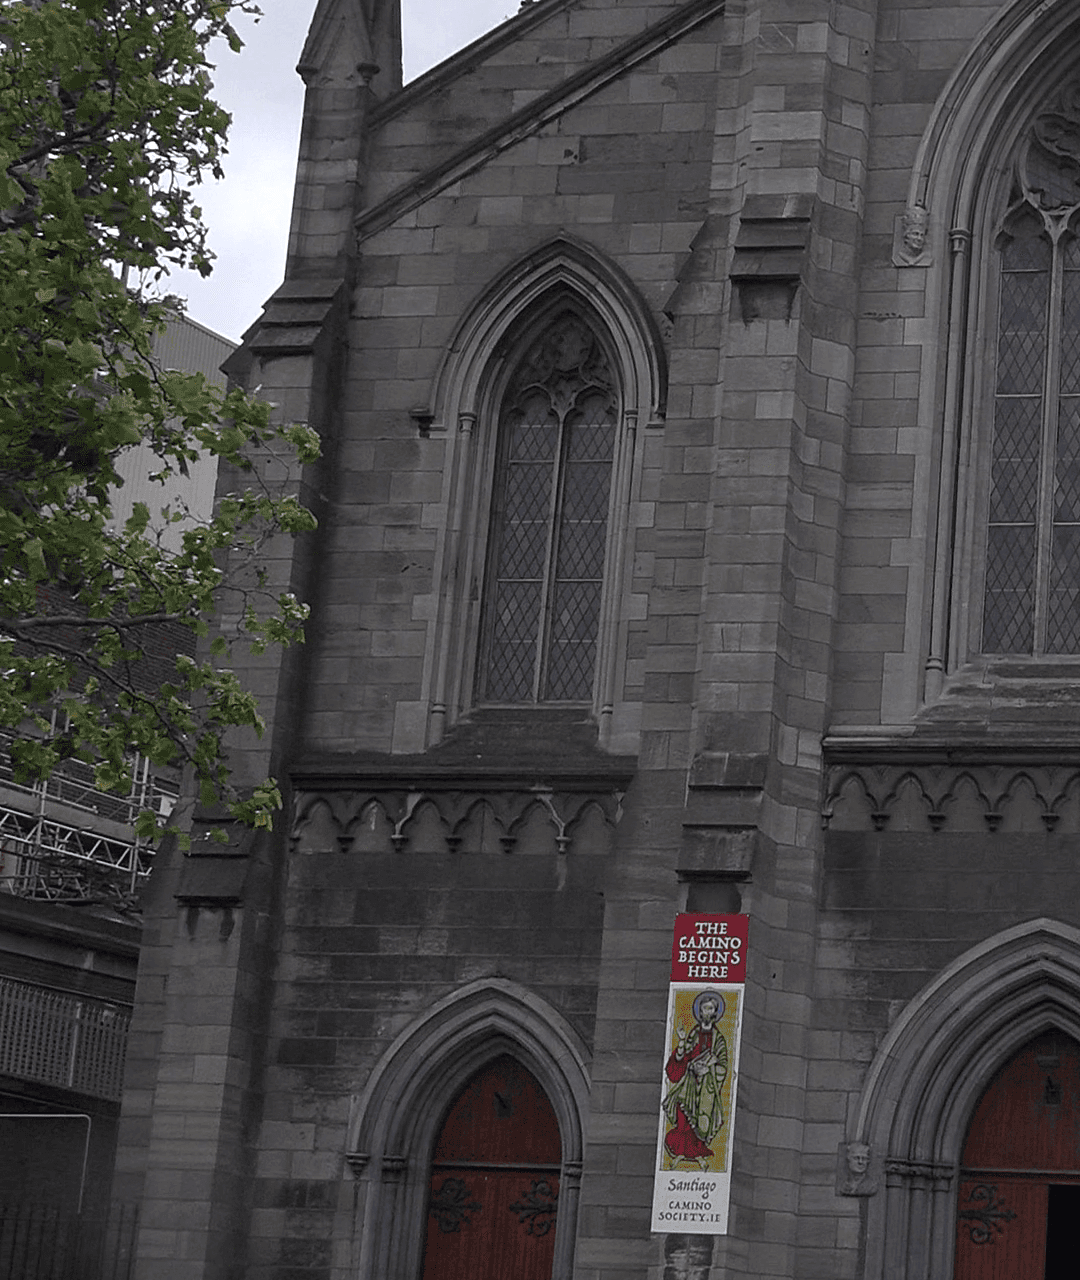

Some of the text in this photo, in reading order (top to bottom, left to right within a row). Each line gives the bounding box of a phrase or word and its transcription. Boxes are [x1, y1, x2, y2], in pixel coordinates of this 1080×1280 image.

[695, 922, 728, 935] THE
[679, 936, 742, 949] CAMINO
[678, 950, 740, 965] BEGINS
[688, 965, 728, 978] HERE
[668, 1177, 717, 1200] Santiago
[669, 1200, 712, 1210] CAMINO
[658, 1211, 721, 1223] SOCIETY.IE
